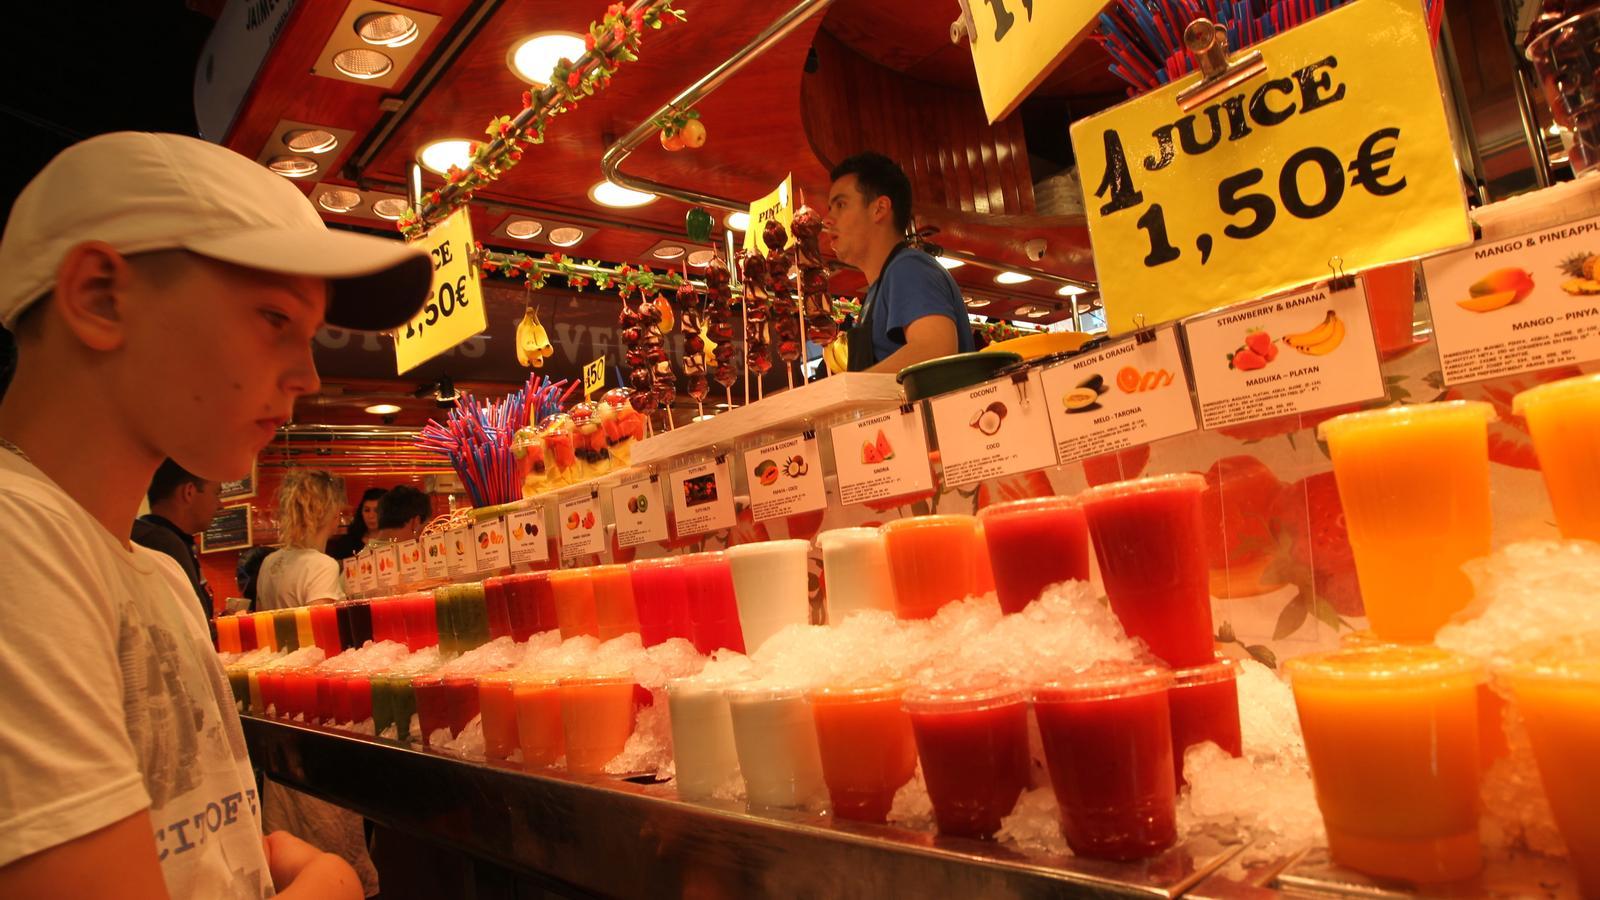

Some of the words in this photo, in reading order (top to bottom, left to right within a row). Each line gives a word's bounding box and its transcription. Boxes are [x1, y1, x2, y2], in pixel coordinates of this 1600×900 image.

[1094, 129, 1143, 216] 1
[1144, 55, 1346, 171] JUICE
[1137, 127, 1407, 267] 1,50€
[1474, 241, 1522, 260] MANGO
[1526, 237, 1536, 247] &
[1217, 305, 1274, 327] STRAWBERRY
[1276, 304, 1284, 312] &
[1285, 292, 1326, 310] BANANA
[1512, 316, 1554, 331] MANGO
[1565, 307, 1599, 321] PINYA
[1073, 357, 1097, 370] MELON
[1105, 344, 1135, 359] ORANGE
[1246, 371, 1282, 387] MADUIXA
[1289, 365, 1320, 378] PLATAN
[970, 386, 997, 399] COCONUT
[858, 415, 891, 428] WATERMELON
